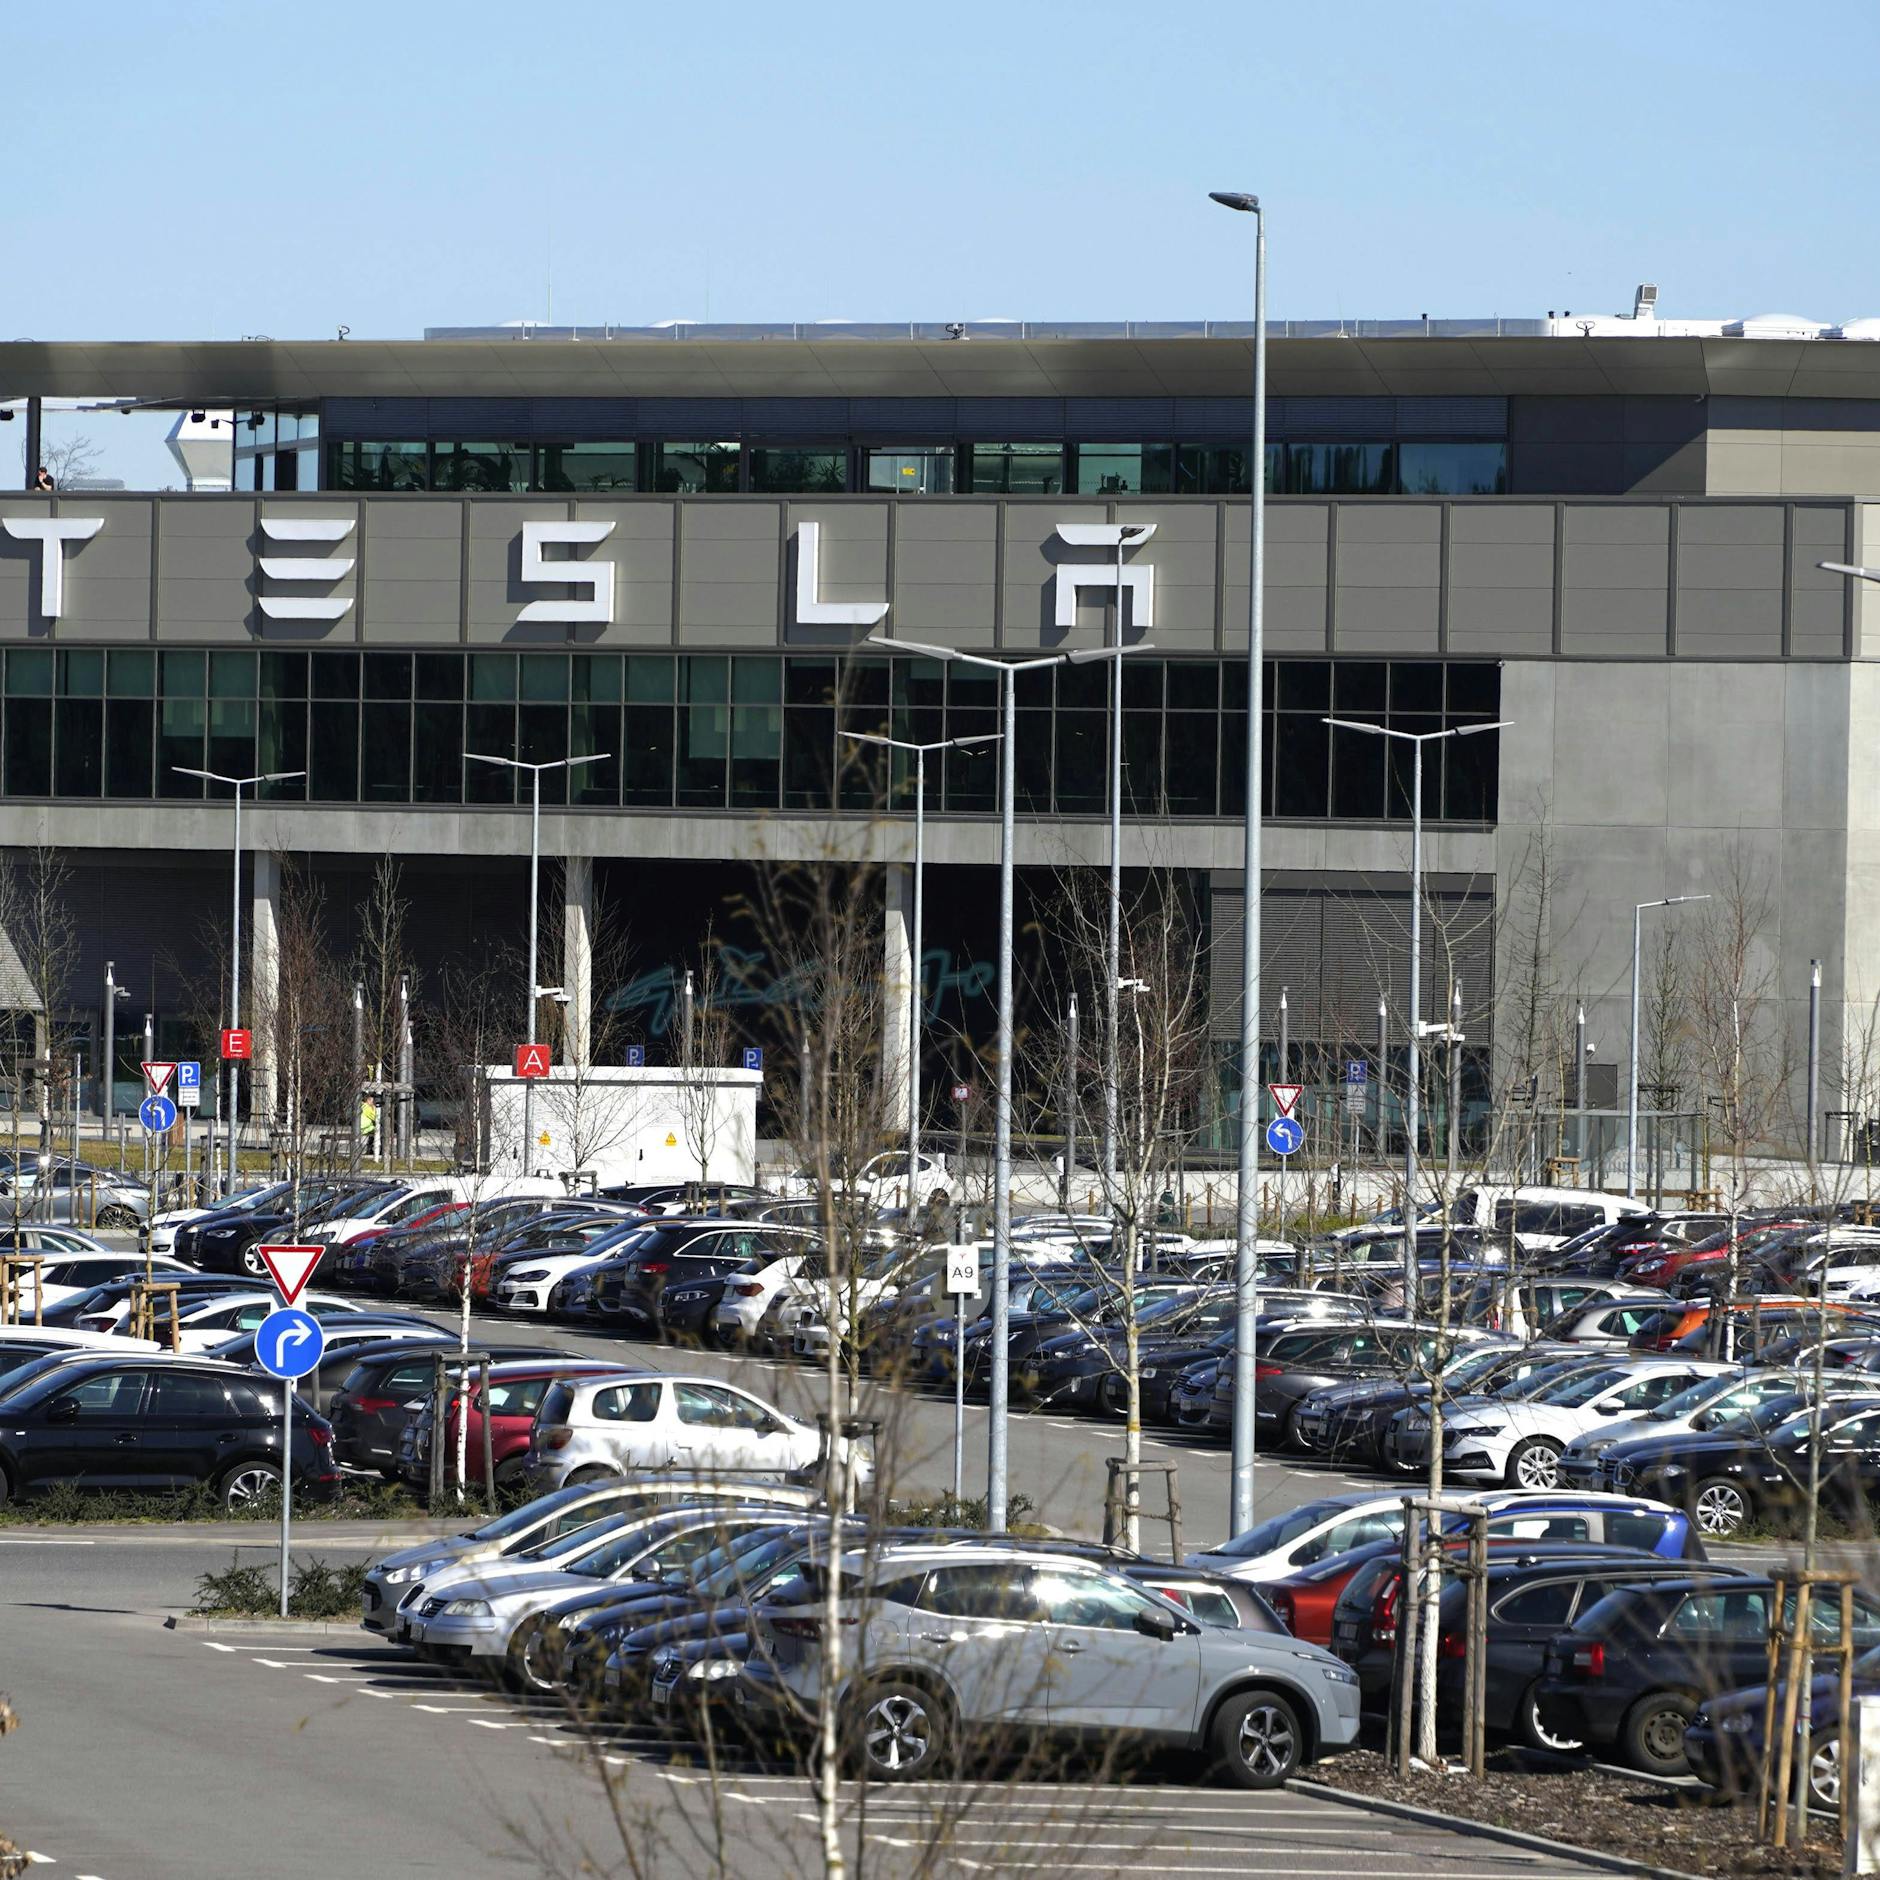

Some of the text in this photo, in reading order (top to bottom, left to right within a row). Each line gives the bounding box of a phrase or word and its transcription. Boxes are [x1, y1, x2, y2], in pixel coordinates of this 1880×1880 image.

[3, 517, 1158, 628] TESLA
[229, 1033, 243, 1053] E
[523, 1049, 544, 1070] A
[629, 1048, 639, 1064] P
[746, 1050, 757, 1067] P
[182, 1065, 194, 1084] P
[952, 1266, 974, 1279] A9
